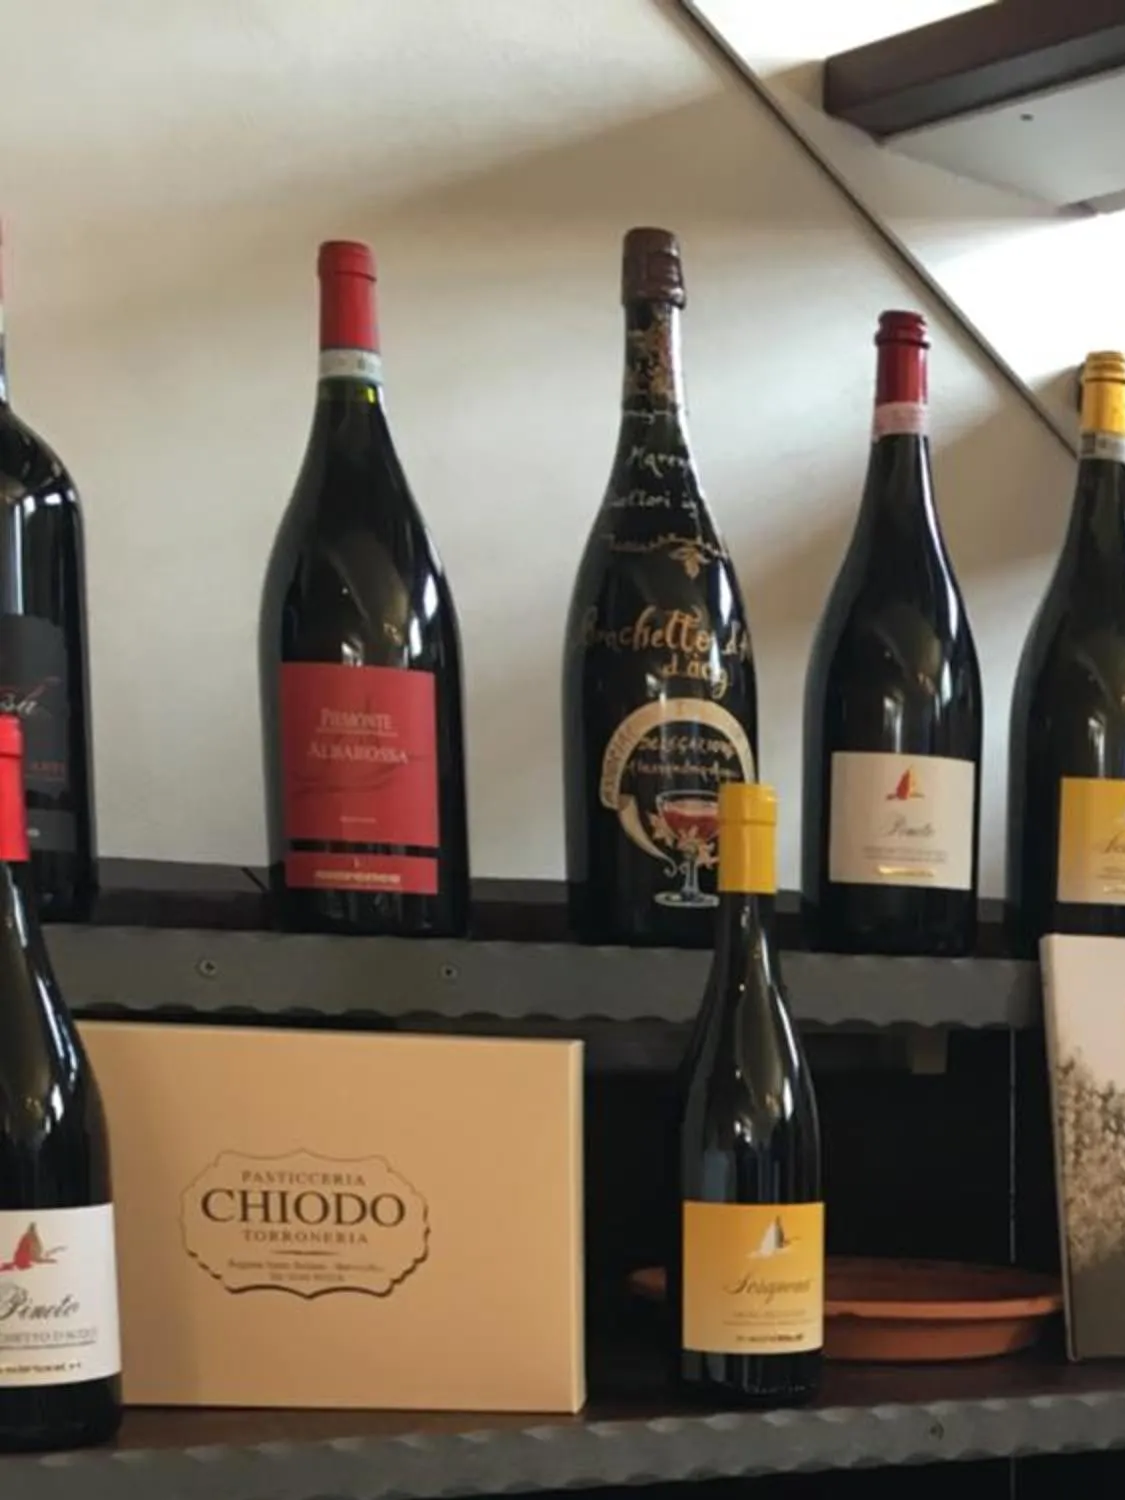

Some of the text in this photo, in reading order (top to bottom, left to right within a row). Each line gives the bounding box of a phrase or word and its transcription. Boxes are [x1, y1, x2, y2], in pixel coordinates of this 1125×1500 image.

[242, 1170, 366, 1186] PASTICCERIA
[201, 1187, 406, 1227] CHIODO
[243, 1230, 369, 1245] TORRONERIA
